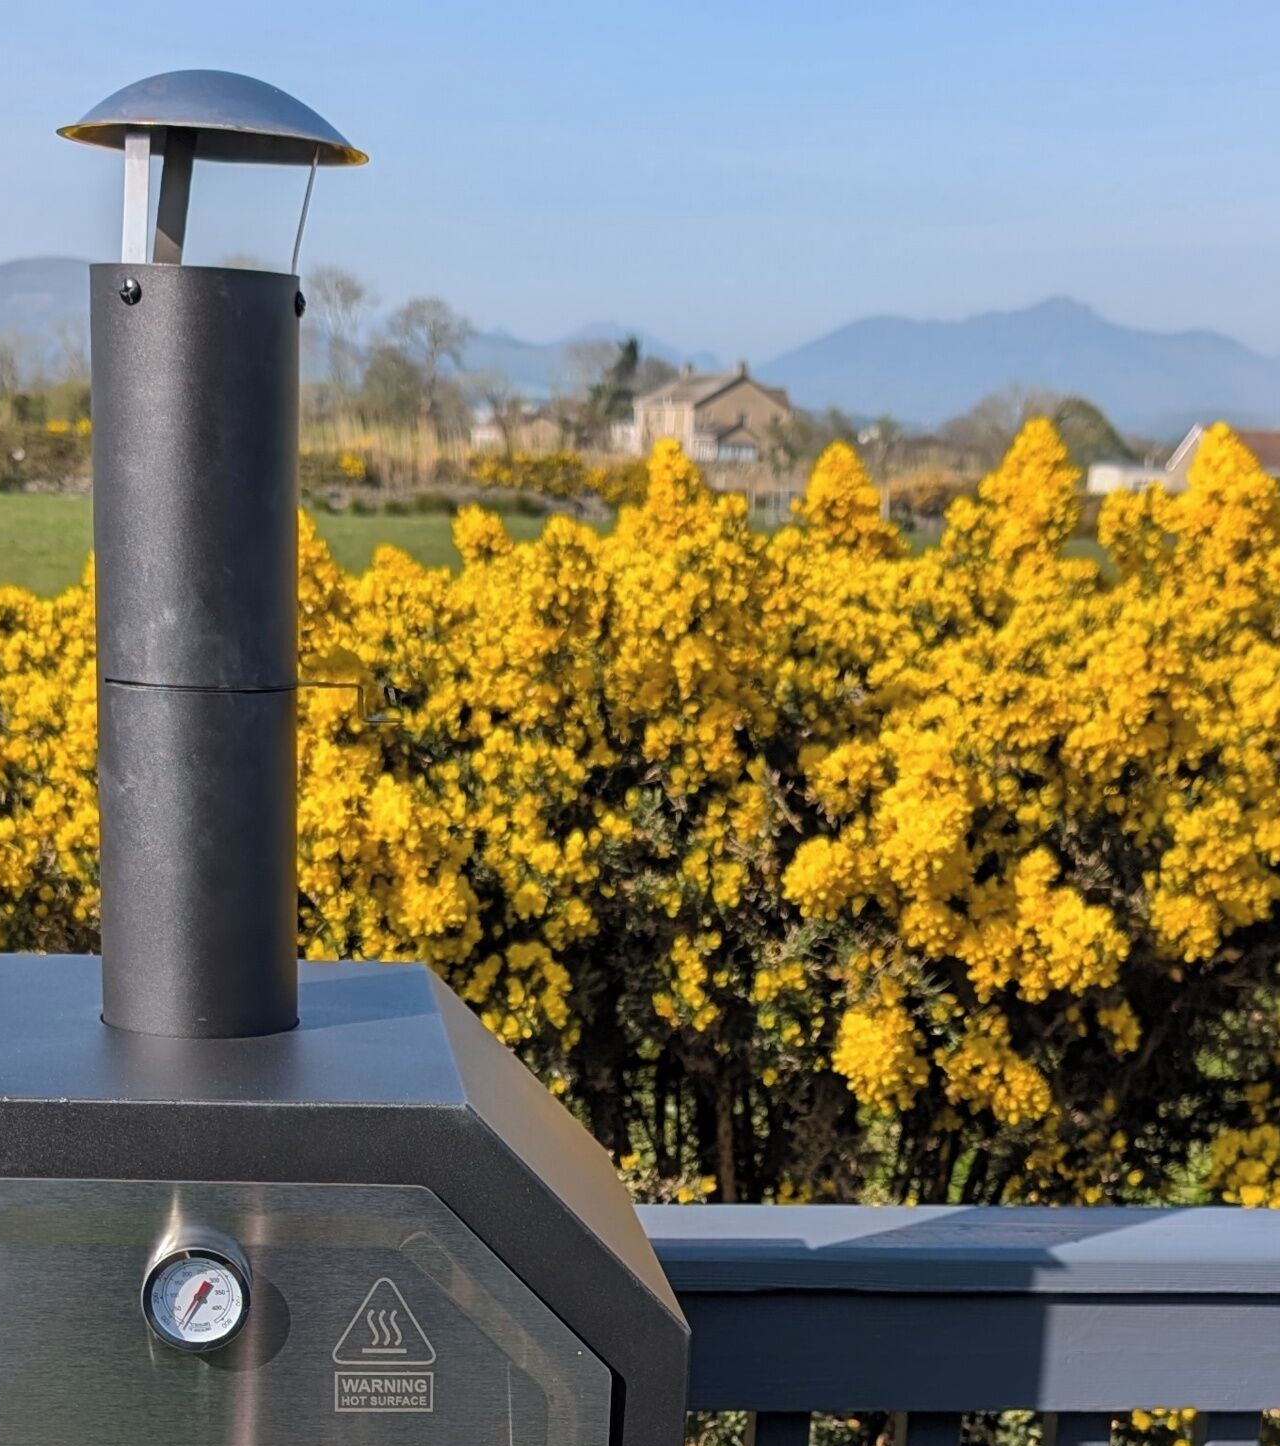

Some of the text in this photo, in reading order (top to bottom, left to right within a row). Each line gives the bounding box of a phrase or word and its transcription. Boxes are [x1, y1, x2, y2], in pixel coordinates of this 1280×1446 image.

[340, 1378, 428, 1393] WARNING
[341, 1395, 428, 1406] HOT SURFACE
